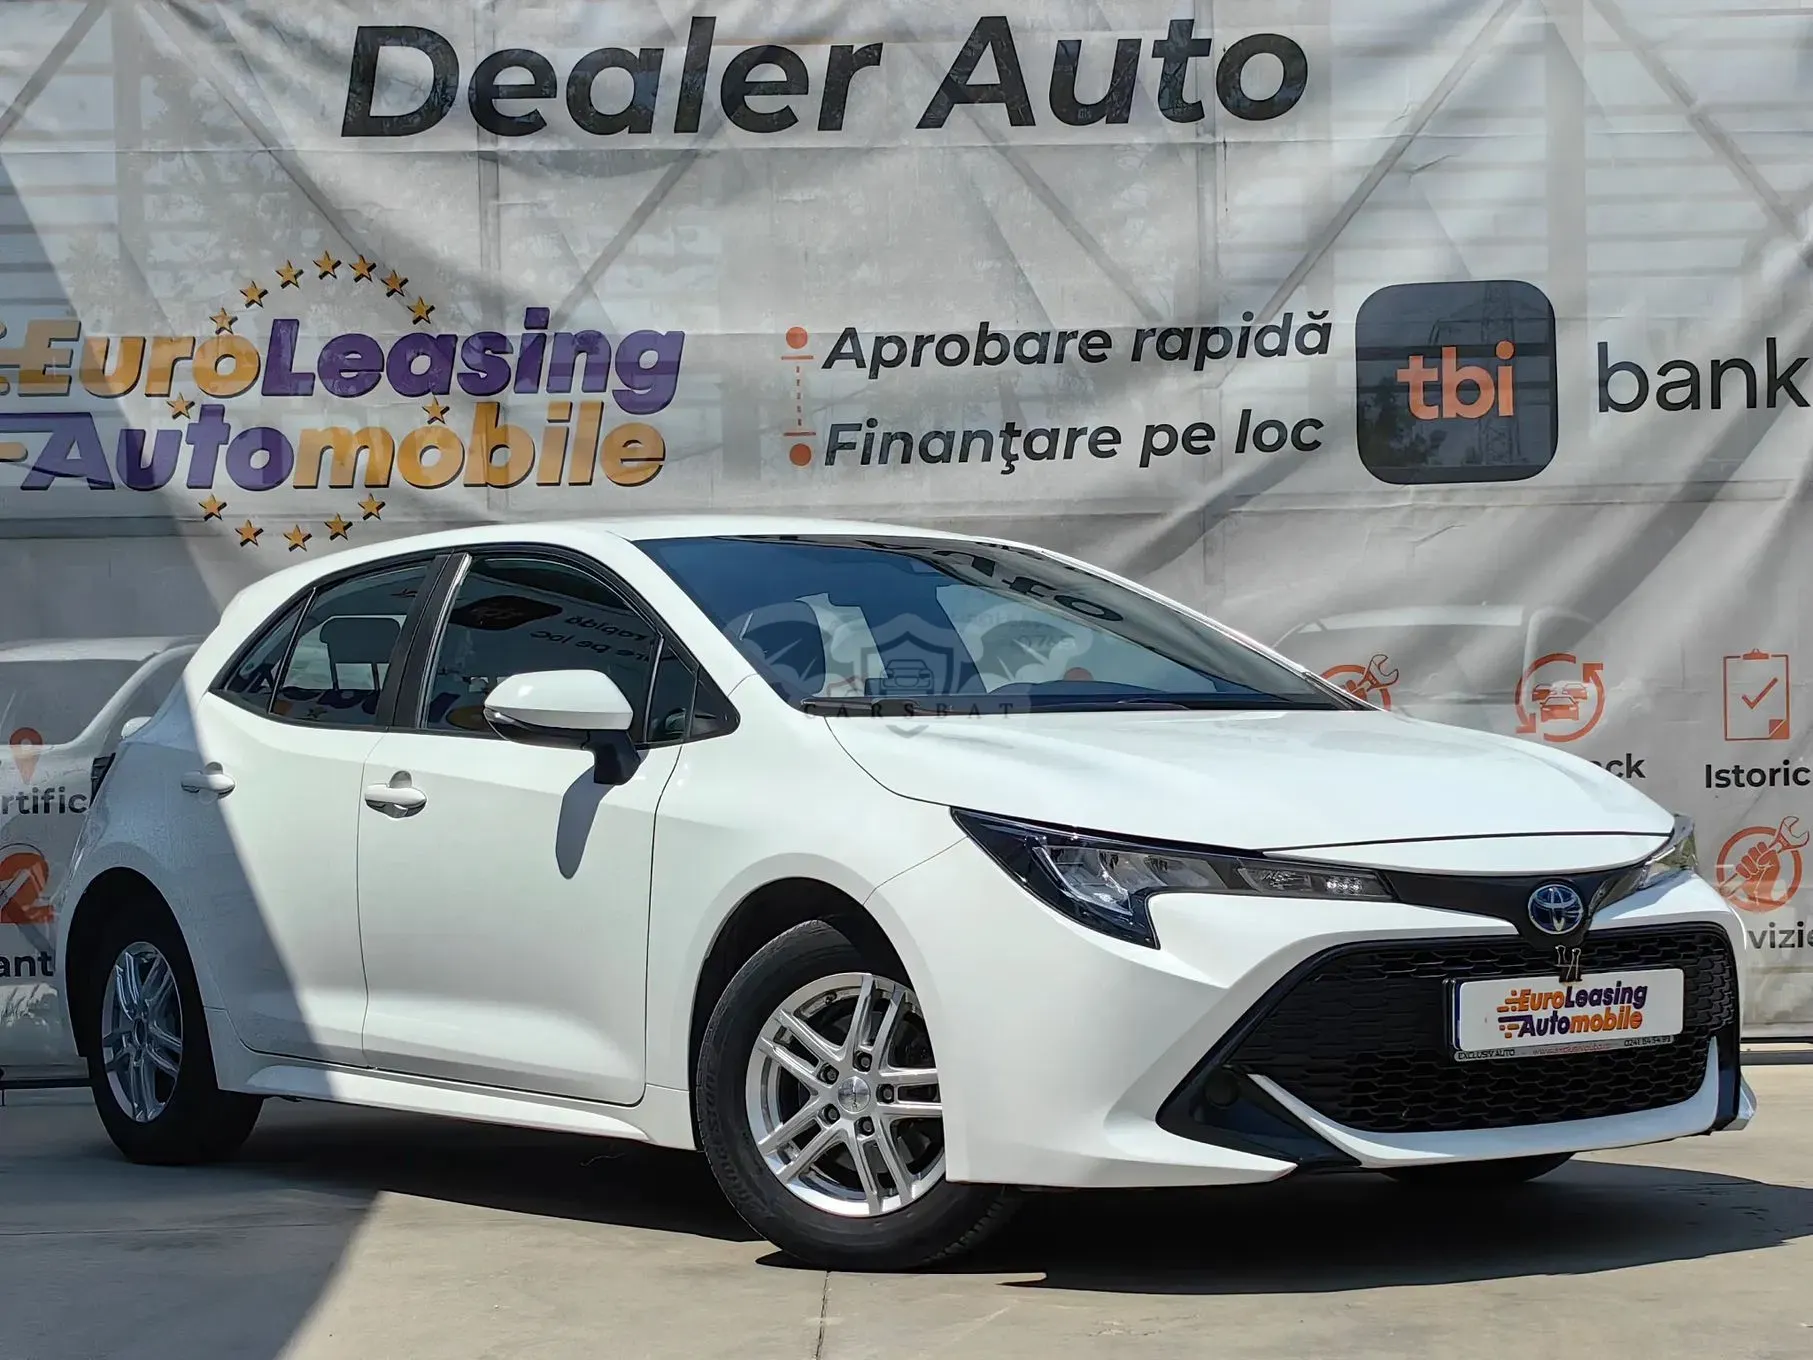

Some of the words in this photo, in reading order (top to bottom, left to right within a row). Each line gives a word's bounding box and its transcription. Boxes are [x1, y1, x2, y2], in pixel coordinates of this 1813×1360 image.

[341, 16, 884, 138] Dealer
[914, 16, 1309, 131] Auto
[16, 307, 686, 415] EuroLeasing
[821, 325, 1114, 380] Aprobare
[1130, 309, 1333, 373] rapidă
[1396, 340, 1515, 421] tbi
[1597, 337, 1811, 413] bank
[19, 401, 667, 492] Automobile
[823, 416, 1123, 476] Finanţare
[1138, 421, 1217, 468] pe
[1234, 408, 1325, 456] loc
[1590, 752, 1646, 779] ck
[1705, 758, 1811, 789] Istoric
[1517, 981, 1648, 1012] EuroLeasing
[1517, 1005, 1643, 1037] Automobile
